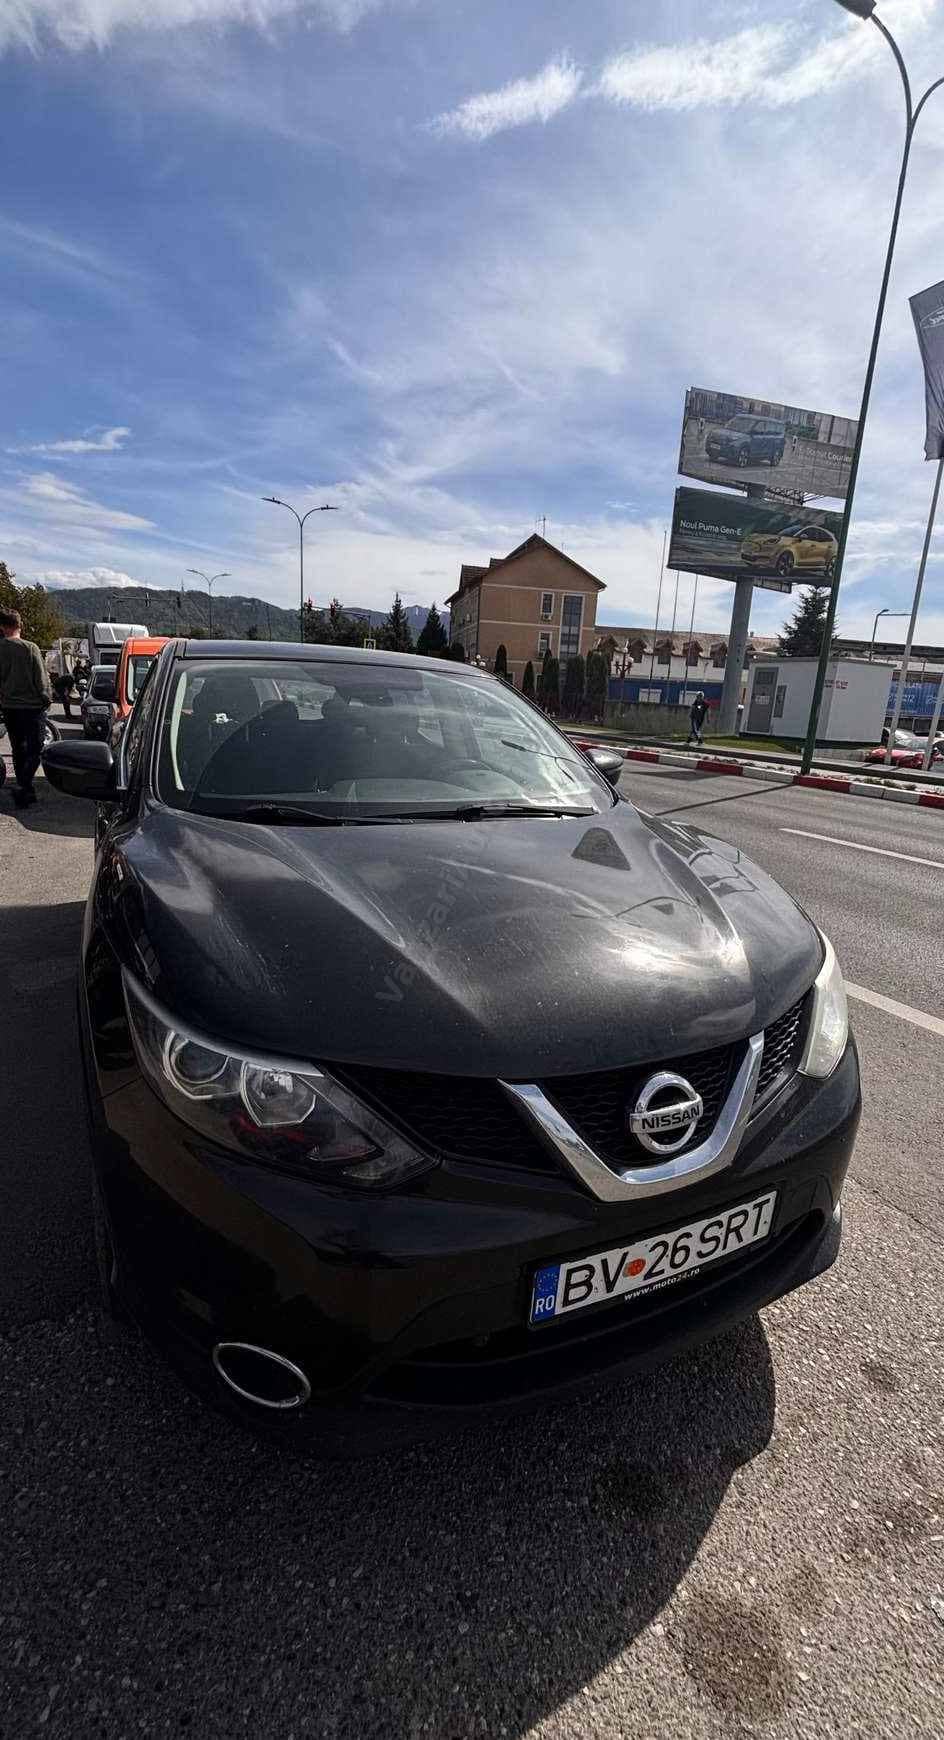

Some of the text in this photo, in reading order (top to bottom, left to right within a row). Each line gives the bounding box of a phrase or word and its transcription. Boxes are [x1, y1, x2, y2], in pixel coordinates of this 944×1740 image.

[680, 519, 697, 530] Noul
[698, 522, 719, 533] Puma
[720, 526, 742, 536] Gen-E
[641, 1104, 700, 1130] NISSAN
[624, 1268, 700, 1301] www.moto24.ro
[535, 1294, 555, 1314] RO
